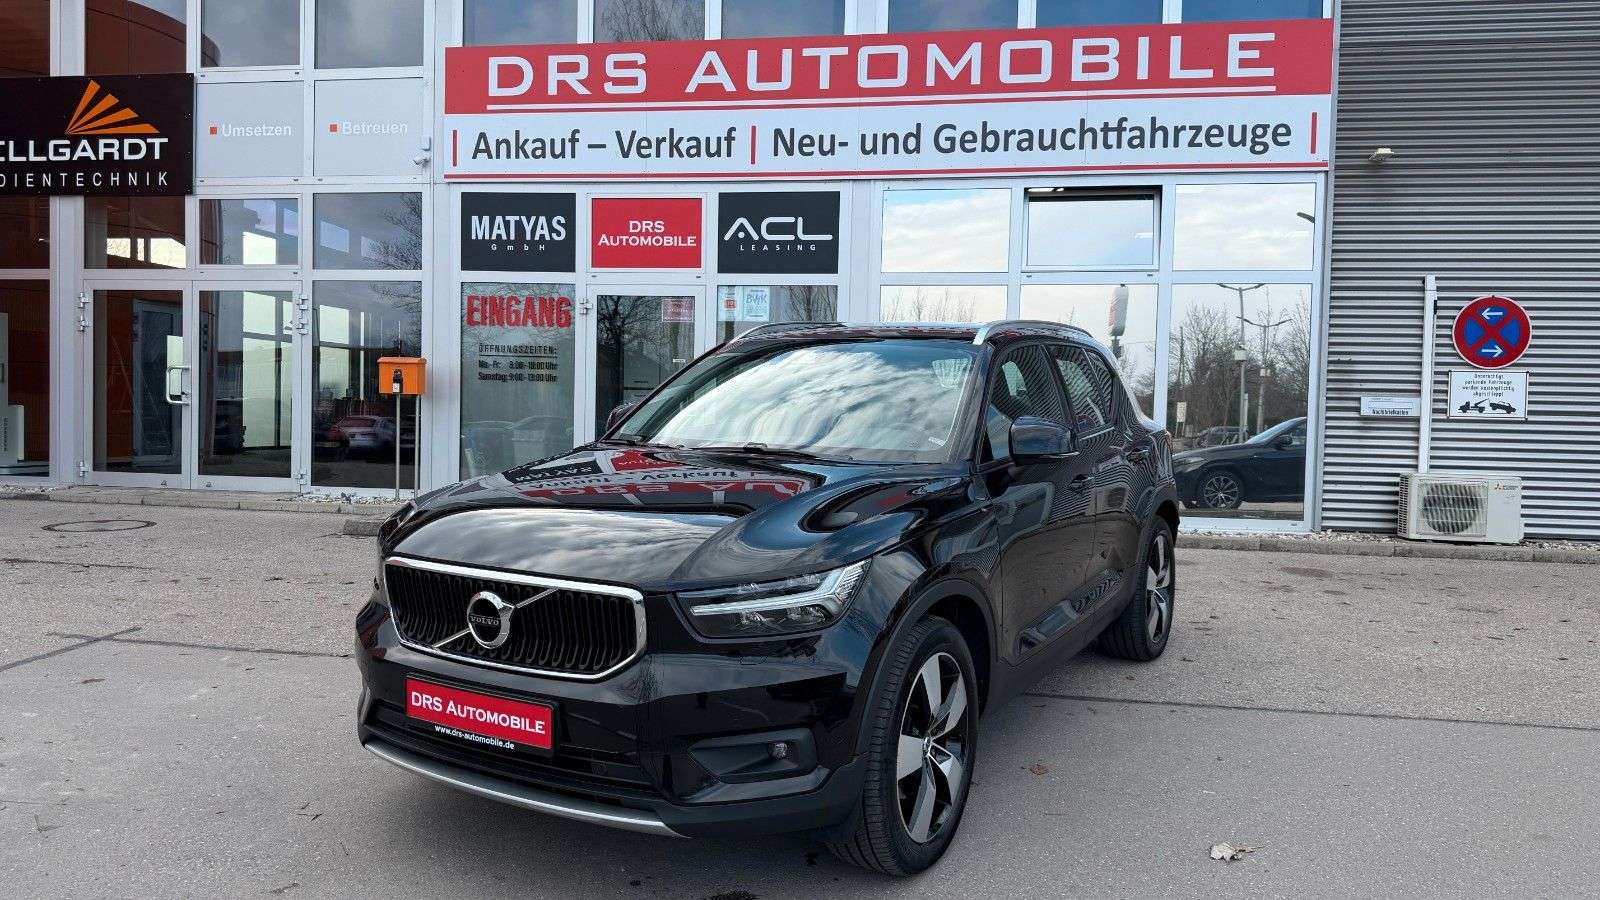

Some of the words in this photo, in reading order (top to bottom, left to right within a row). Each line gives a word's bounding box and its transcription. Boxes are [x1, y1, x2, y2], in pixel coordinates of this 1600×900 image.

[488, 52, 647, 97] DRS
[685, 32, 1276, 93] AUTOMOBILE
[222, 123, 292, 137] Umsetzen
[342, 121, 408, 135] Betreuen
[471, 129, 579, 160] Ankauf
[615, 126, 736, 159] Verkauf
[773, 127, 849, 157] Neu-
[860, 123, 921, 155] und
[933, 116, 1291, 156] Gebrauchtfahrzeuge
[0, 138, 169, 162] LLGARDT
[471, 215, 566, 241] MATYAS
[628, 220, 665, 233] DRS
[723, 216, 833, 241] ACL
[598, 233, 697, 247] AUTOMOBILE
[466, 295, 573, 328] EINGANG
[470, 615, 500, 625] VOLVO
[411, 691, 443, 712] DRS
[446, 700, 546, 735] AUTOMOBILE
[434, 725, 515, 750] www.drs-automobile.de
